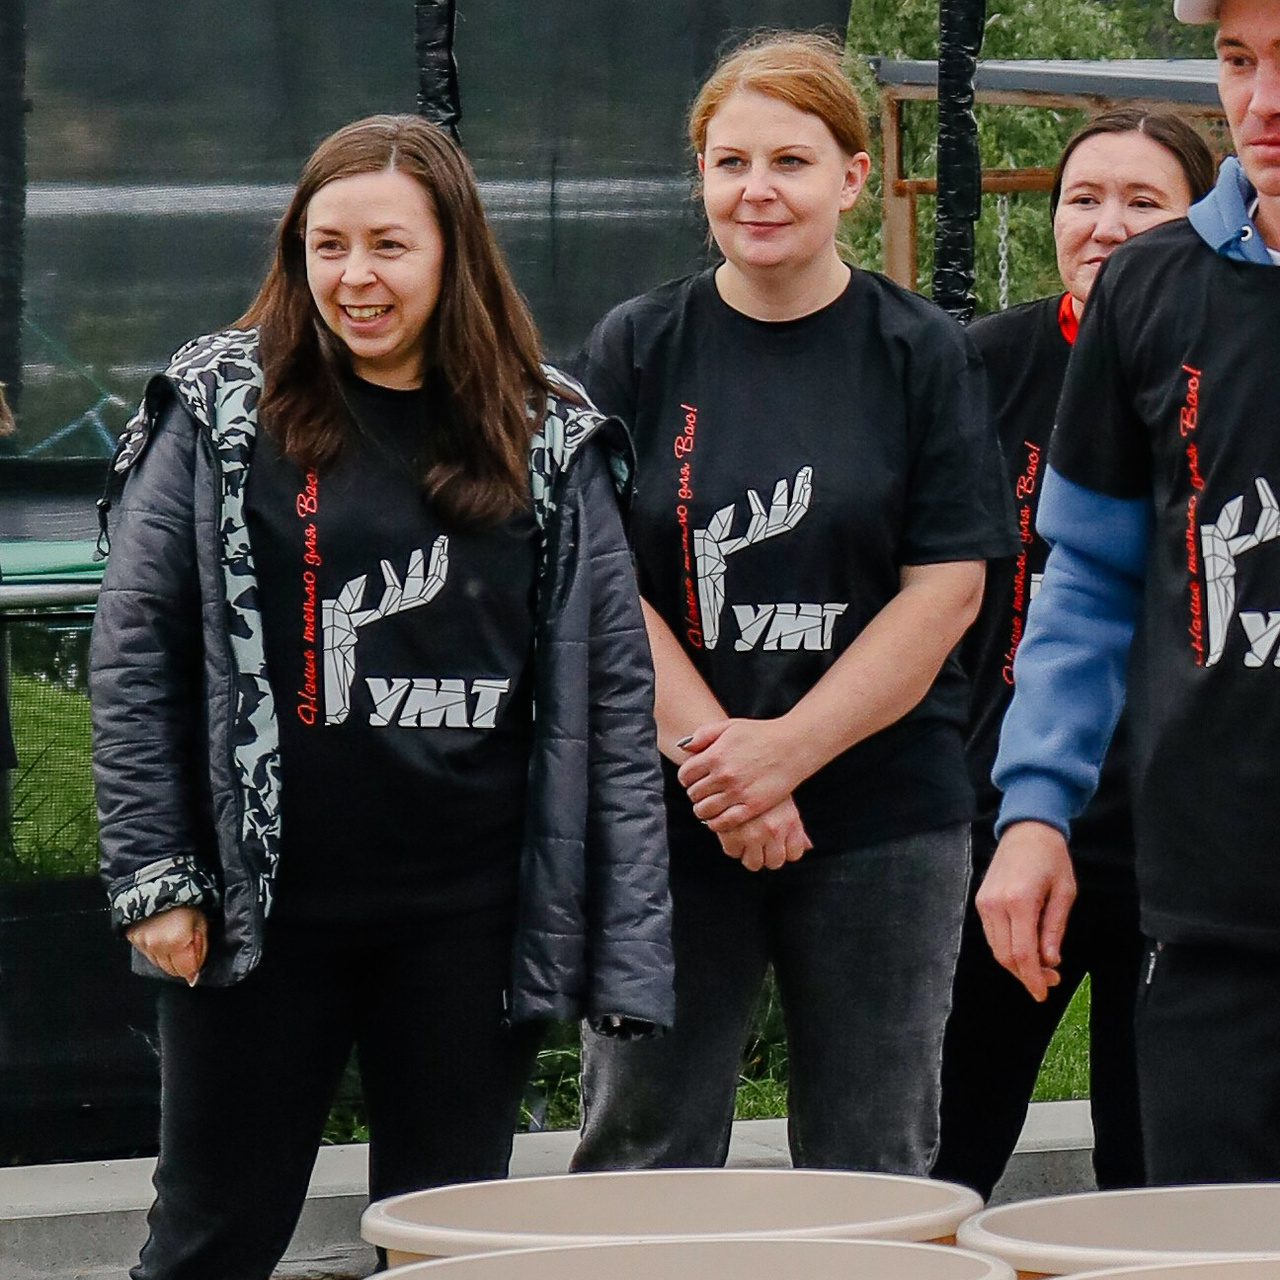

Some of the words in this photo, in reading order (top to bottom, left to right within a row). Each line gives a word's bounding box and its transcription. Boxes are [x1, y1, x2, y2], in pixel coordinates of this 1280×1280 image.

[1179, 363, 1201, 437] Вас!
[674, 403, 698, 459] Вас!
[296, 472, 318, 519] Вас
[1016, 440, 1041, 499] Вас!
[303, 523, 322, 566] для
